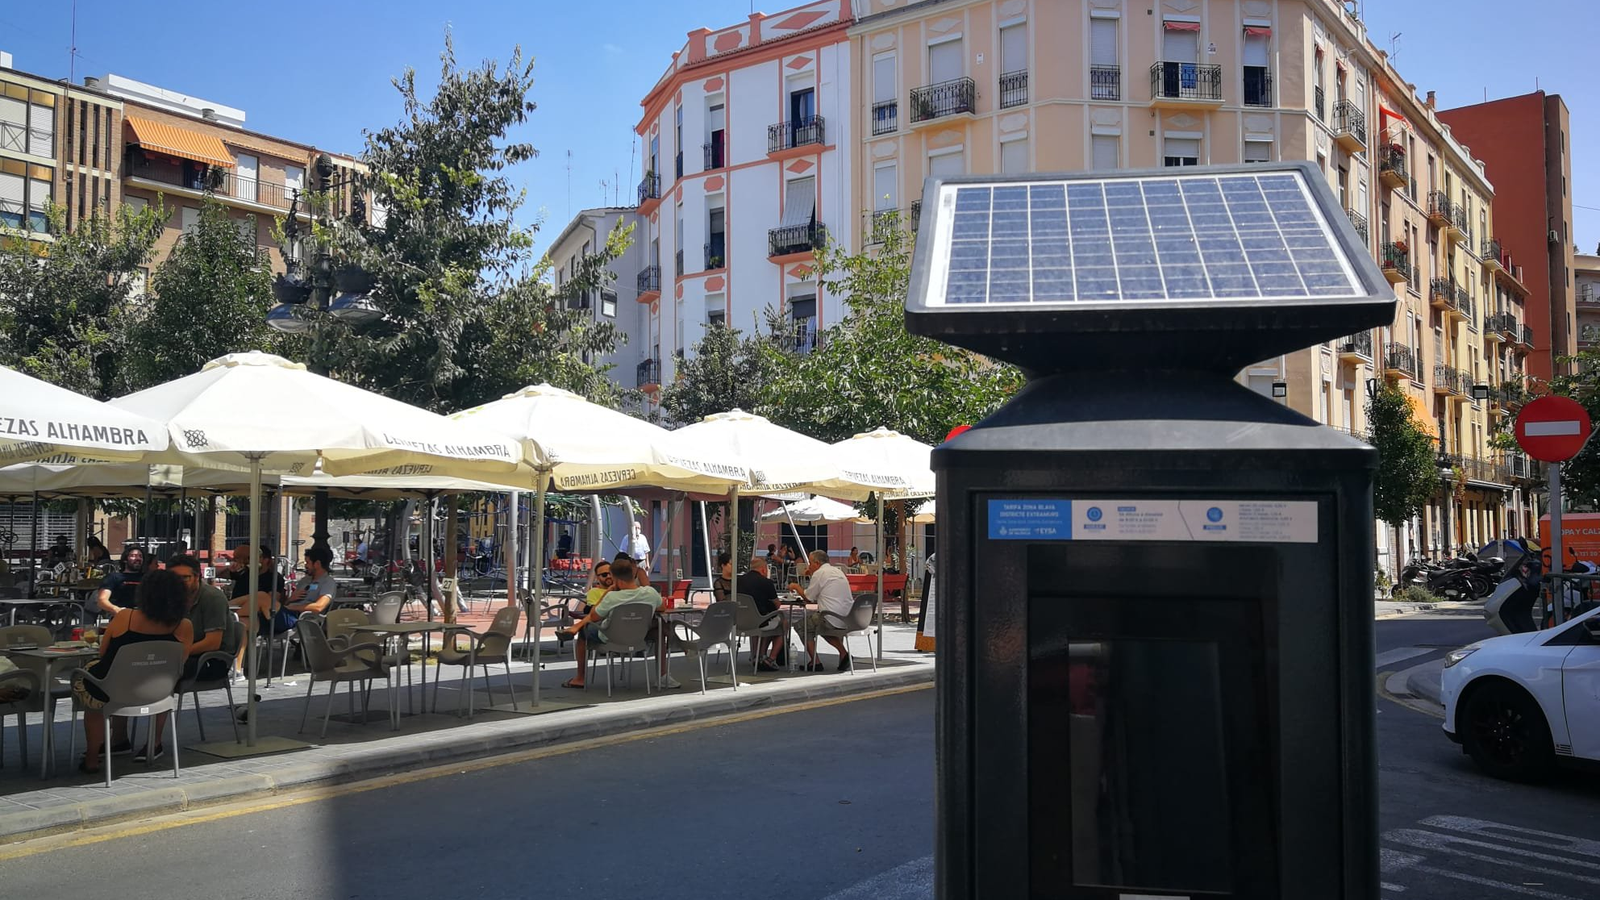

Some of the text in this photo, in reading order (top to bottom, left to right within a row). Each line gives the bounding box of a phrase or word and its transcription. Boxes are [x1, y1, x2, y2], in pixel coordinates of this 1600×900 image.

[47, 421, 149, 446] ALHAMBRA
[444, 444, 511, 458] ALHAMBRA
[703, 462, 747, 479] ALHAMBRA
[205, 567, 215, 577] 21
[443, 580, 453, 589] 27
